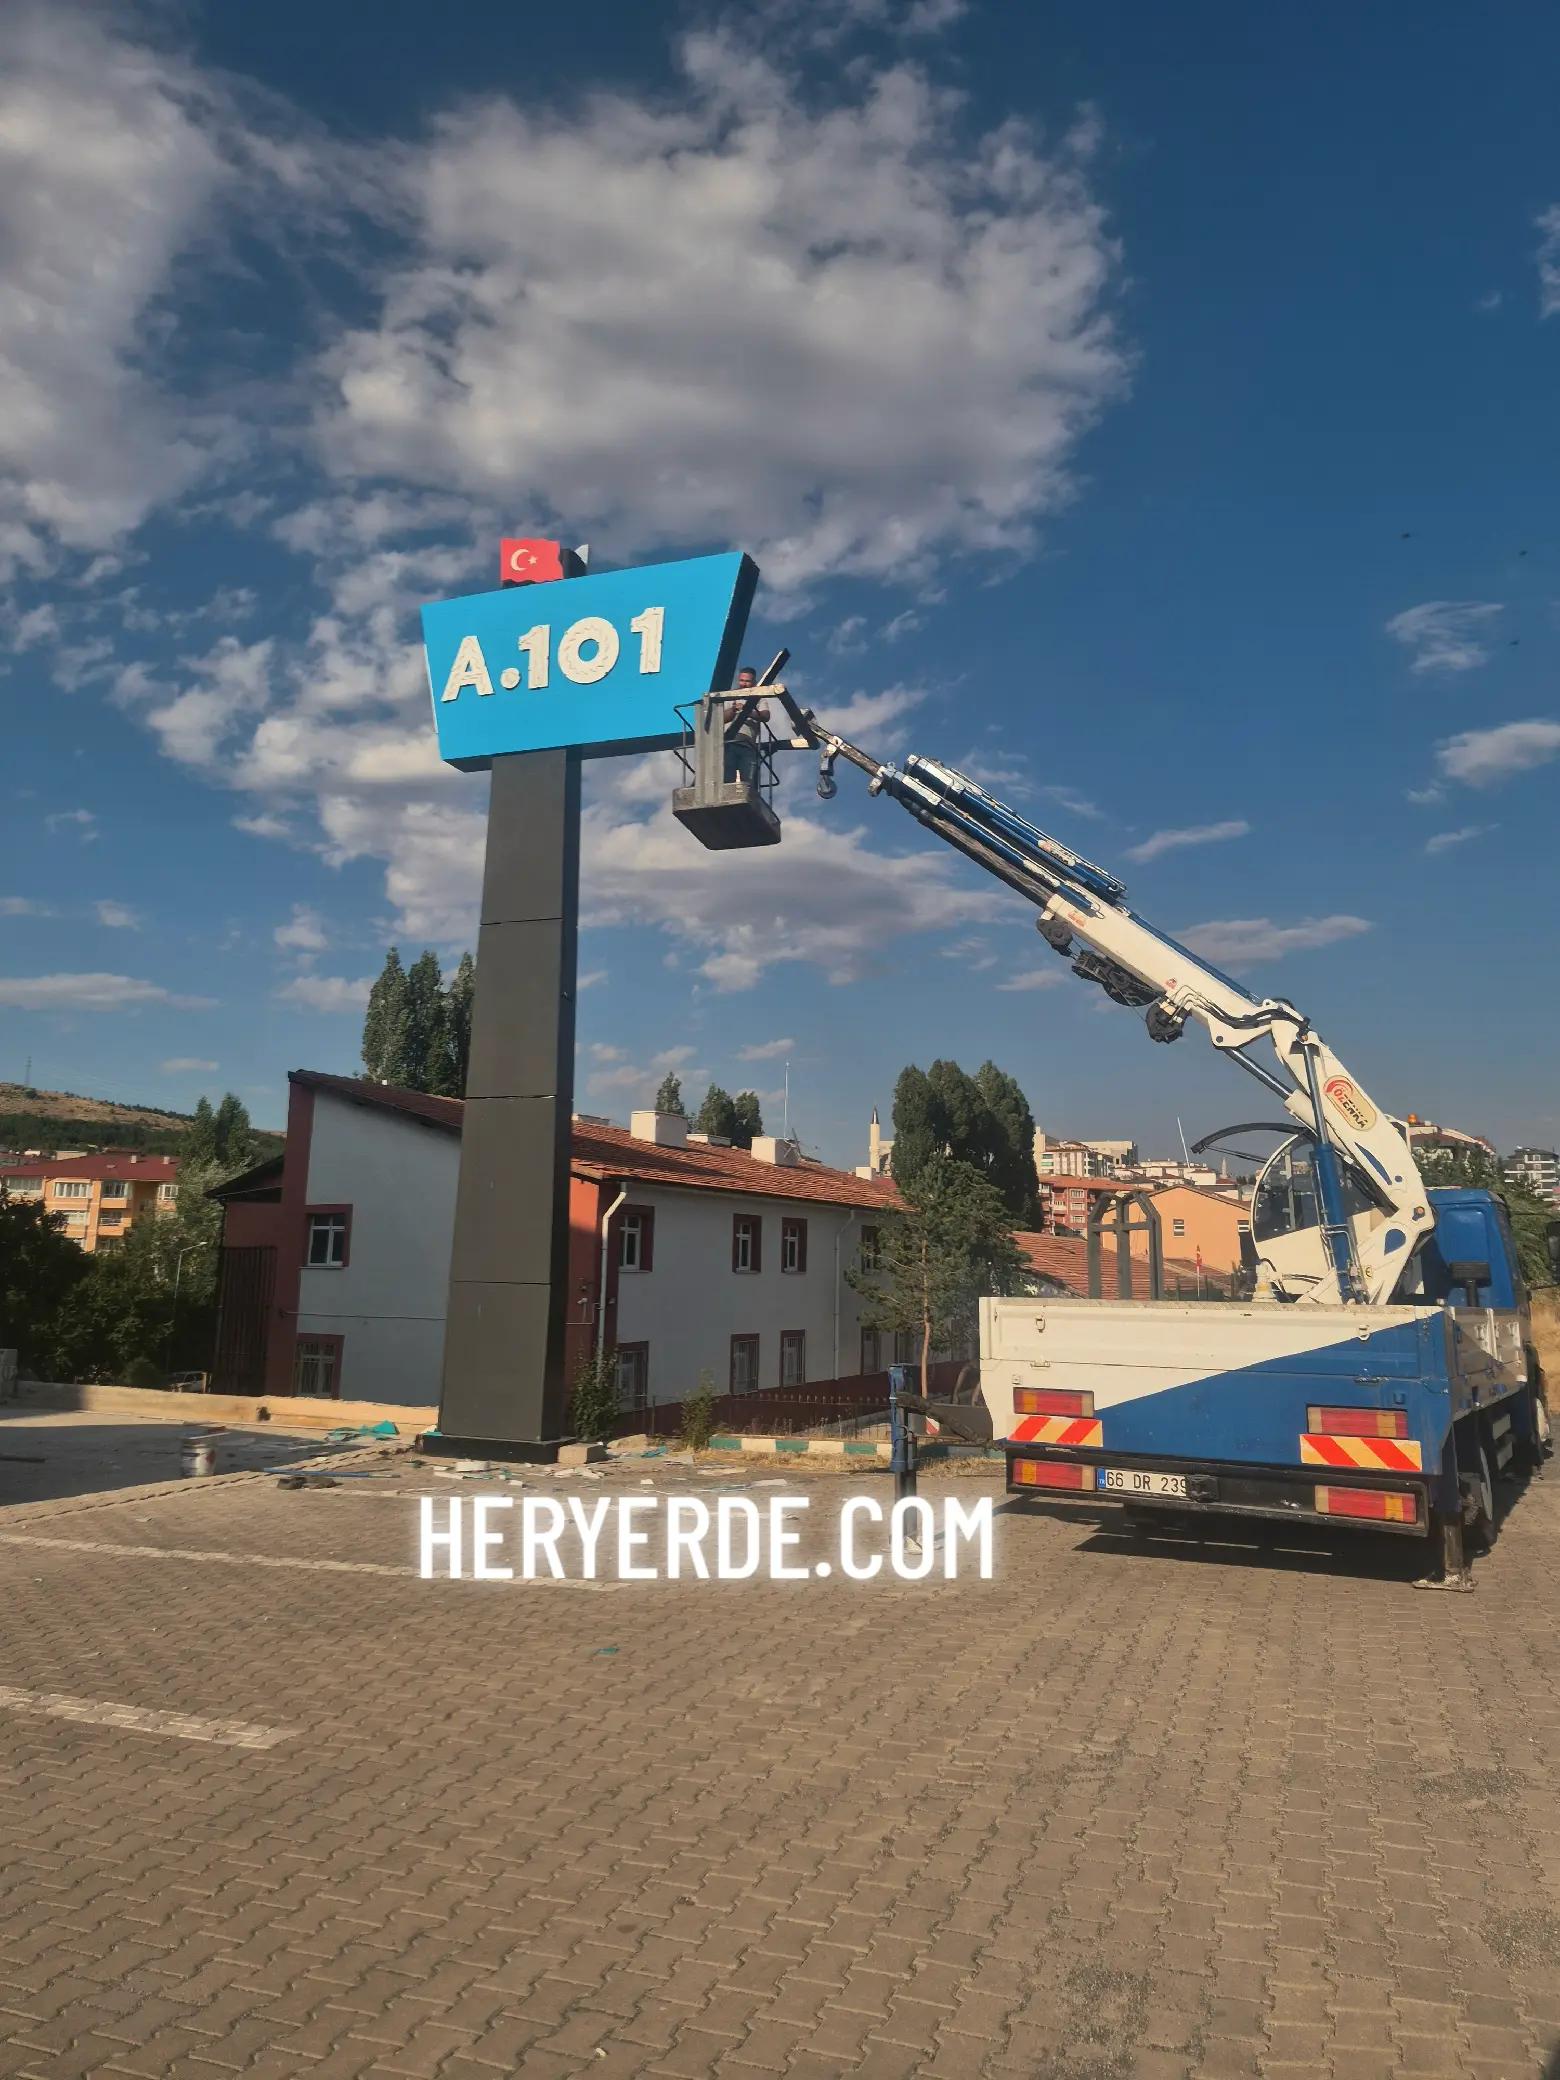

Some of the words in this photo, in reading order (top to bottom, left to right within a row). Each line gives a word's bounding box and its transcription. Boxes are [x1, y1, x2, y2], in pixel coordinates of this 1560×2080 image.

[441, 606, 665, 702] A.101
[1107, 1471, 1124, 1487] 66
[1133, 1474, 1151, 1490] DR
